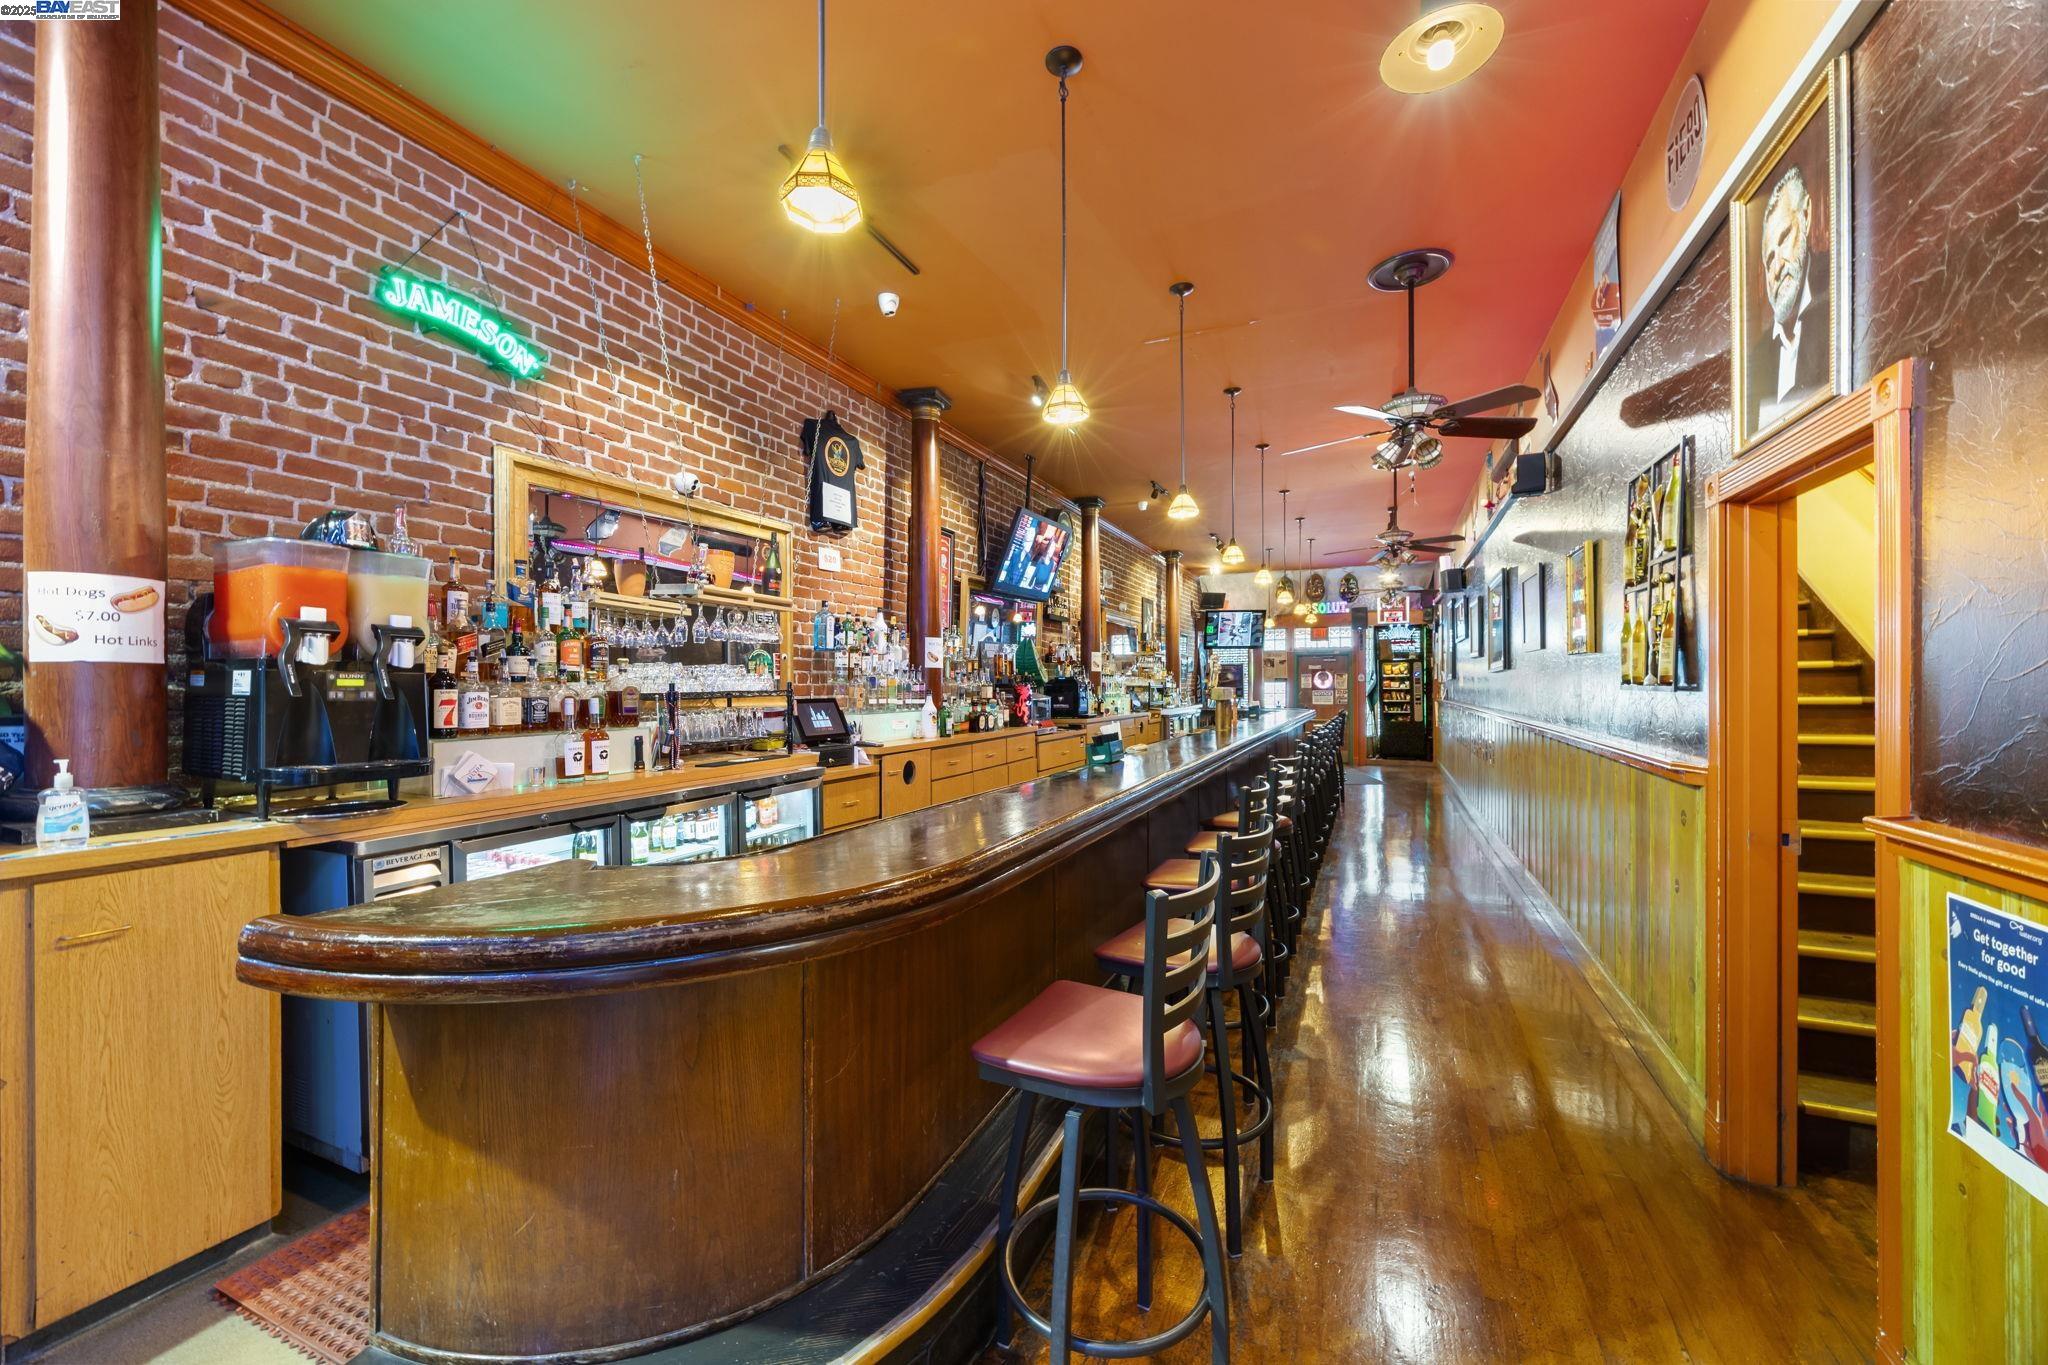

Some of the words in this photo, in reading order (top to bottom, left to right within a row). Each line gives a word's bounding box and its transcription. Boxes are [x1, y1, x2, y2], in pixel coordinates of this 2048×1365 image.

[1667, 94, 1701, 184] FIERO
[384, 277, 534, 376] JAMESON
[66, 587, 106, 600] Dogs
[75, 609, 121, 622] $7.00
[94, 635, 123, 646] Hot
[128, 636, 158, 648] Links
[439, 699, 457, 726] 7
[1973, 928, 1990, 946] Get
[1991, 936, 2039, 966] together
[1981, 949, 1996, 966] for
[1997, 959, 2026, 979] good
